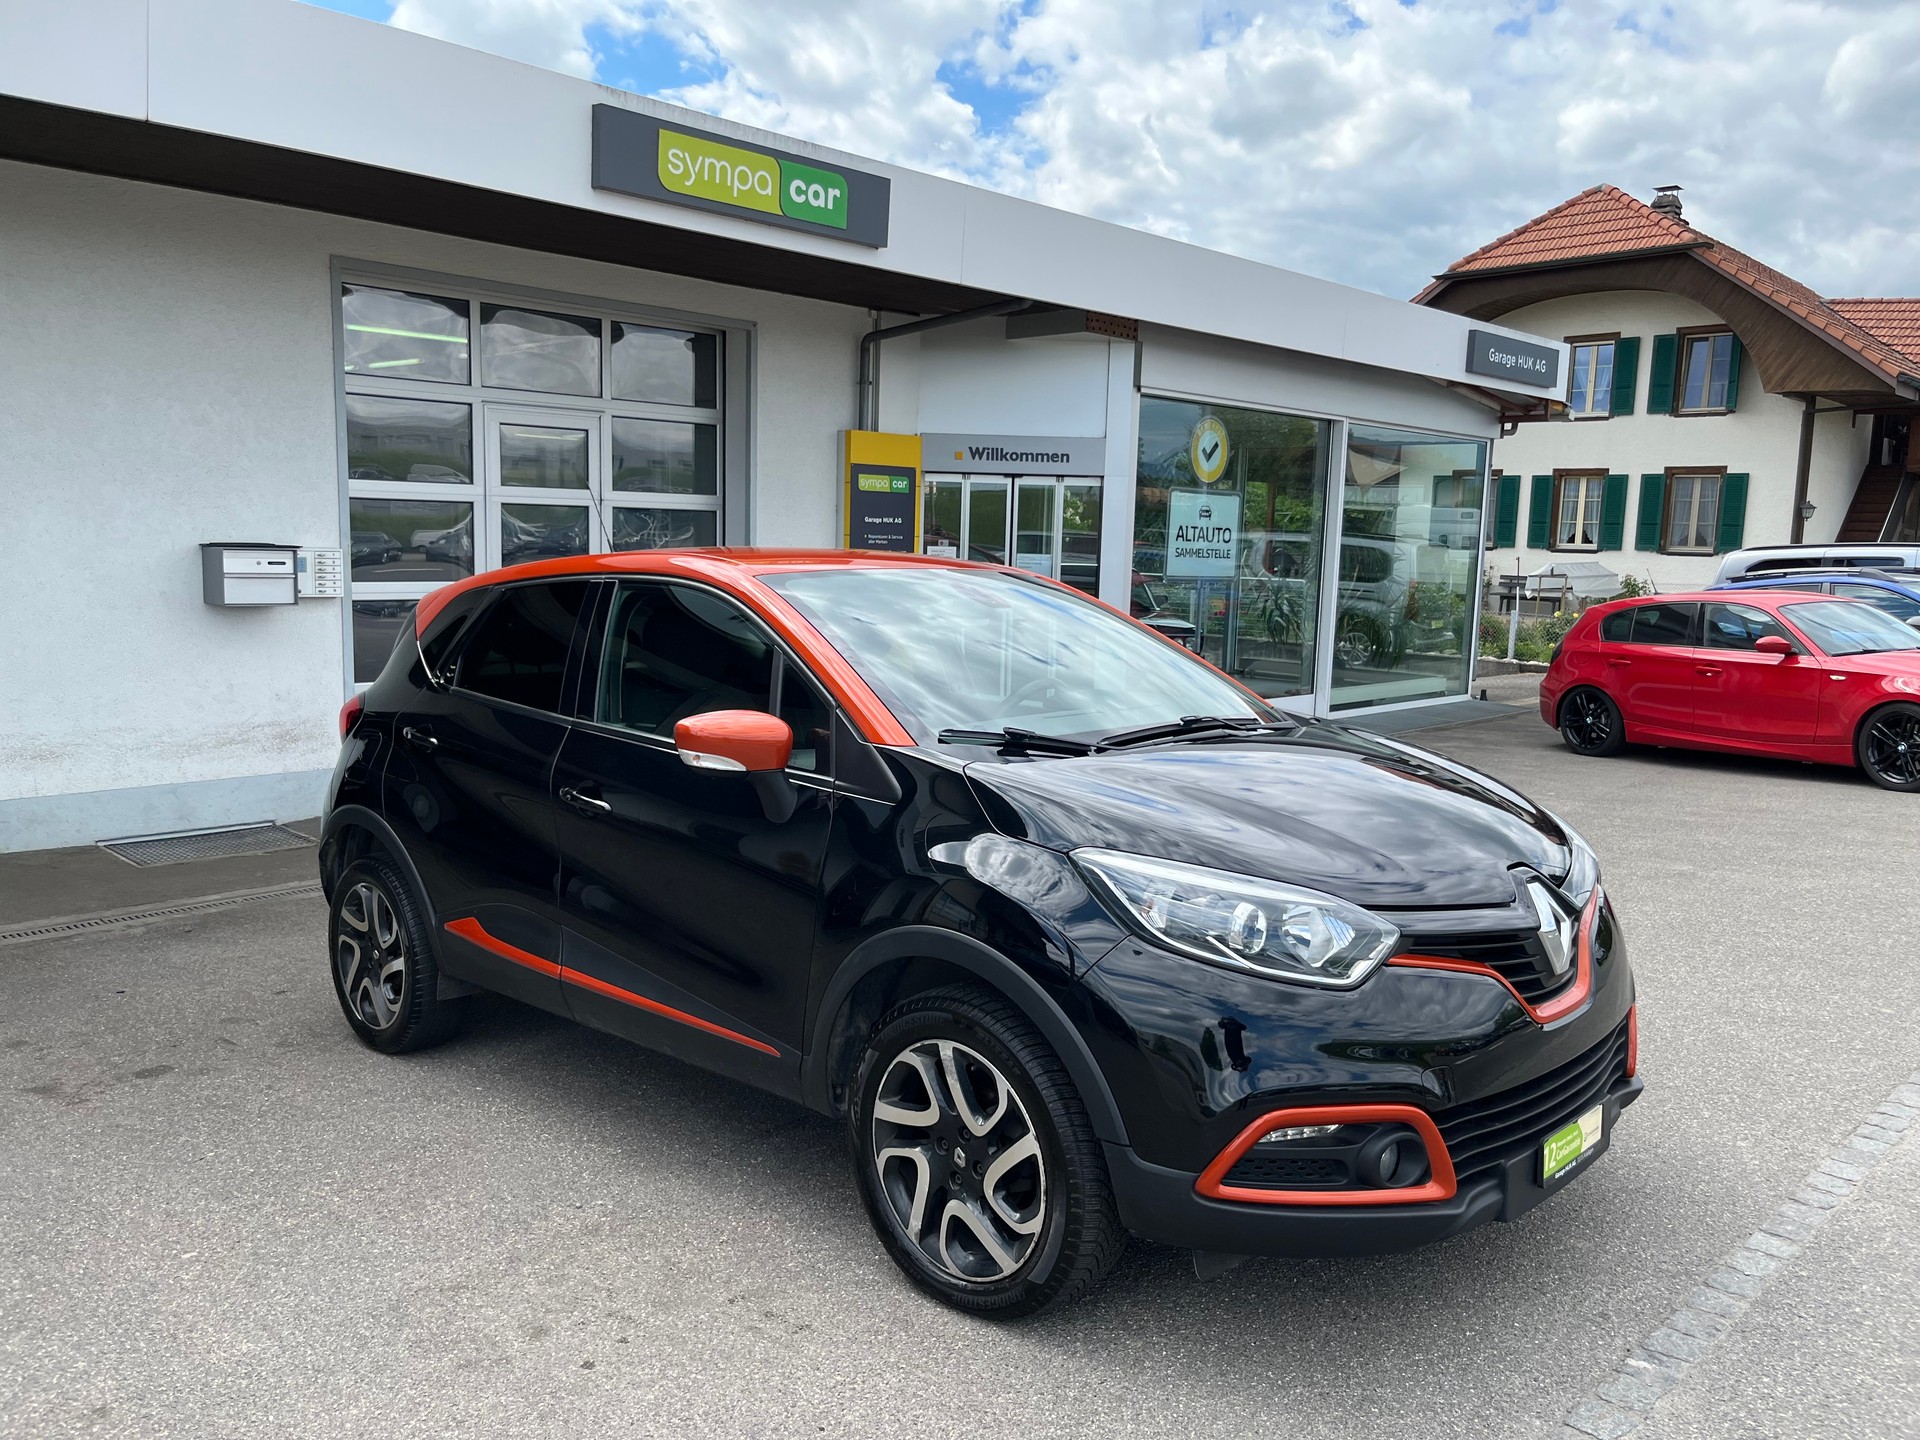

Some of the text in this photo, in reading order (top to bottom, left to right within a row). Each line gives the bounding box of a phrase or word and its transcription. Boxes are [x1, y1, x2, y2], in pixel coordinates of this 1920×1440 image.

[668, 148, 840, 210] sympa car
[1488, 348, 1546, 373] Garage HUK AG
[968, 446, 1070, 463] Willkommen
[860, 478, 907, 489] sympa car
[864, 516, 882, 524] Garage
[1175, 525, 1232, 544] ALTAUTO
[1175, 548, 1231, 559] SAMMELSTELLE
[1544, 1142, 1557, 1171] 12
